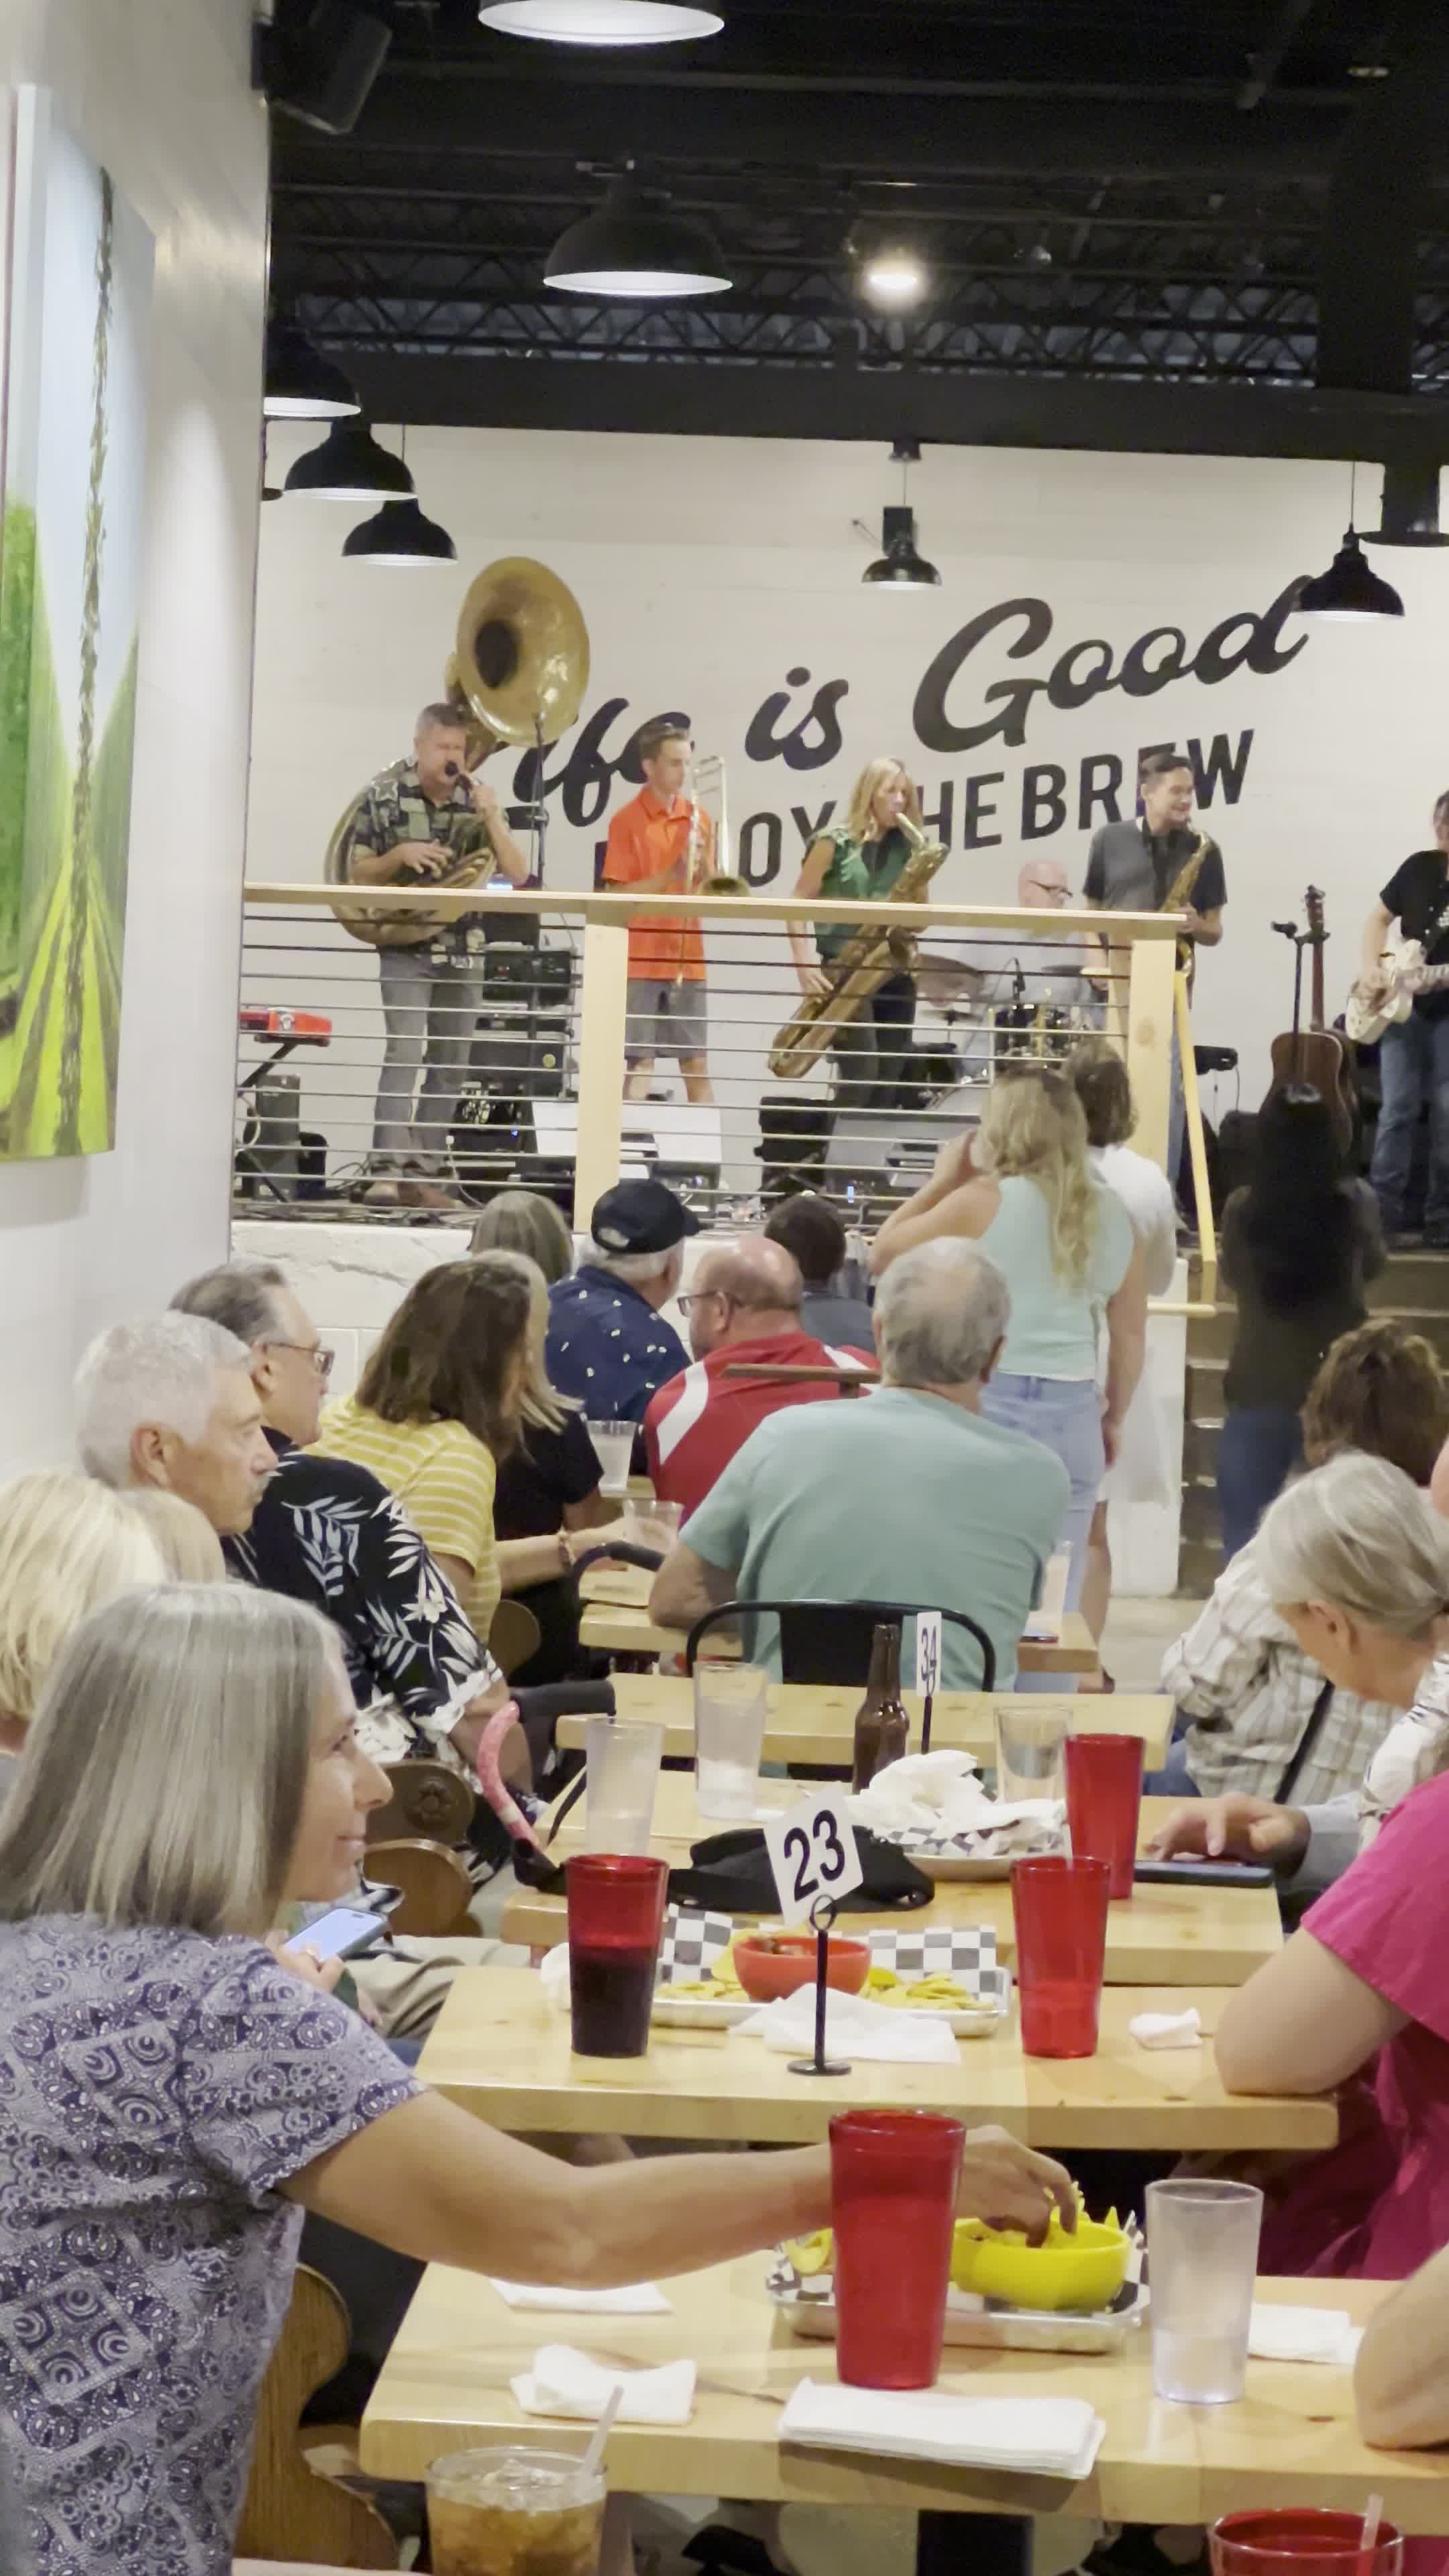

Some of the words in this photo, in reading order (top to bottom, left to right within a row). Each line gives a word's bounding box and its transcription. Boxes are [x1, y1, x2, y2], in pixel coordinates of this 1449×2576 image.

[513, 698, 694, 827] ife
[745, 665, 849, 770] is
[912, 574, 1315, 753] Good
[916, 771, 1005, 851] HE
[921, 1625, 937, 1681] 34
[784, 1809, 845, 1902] 23
